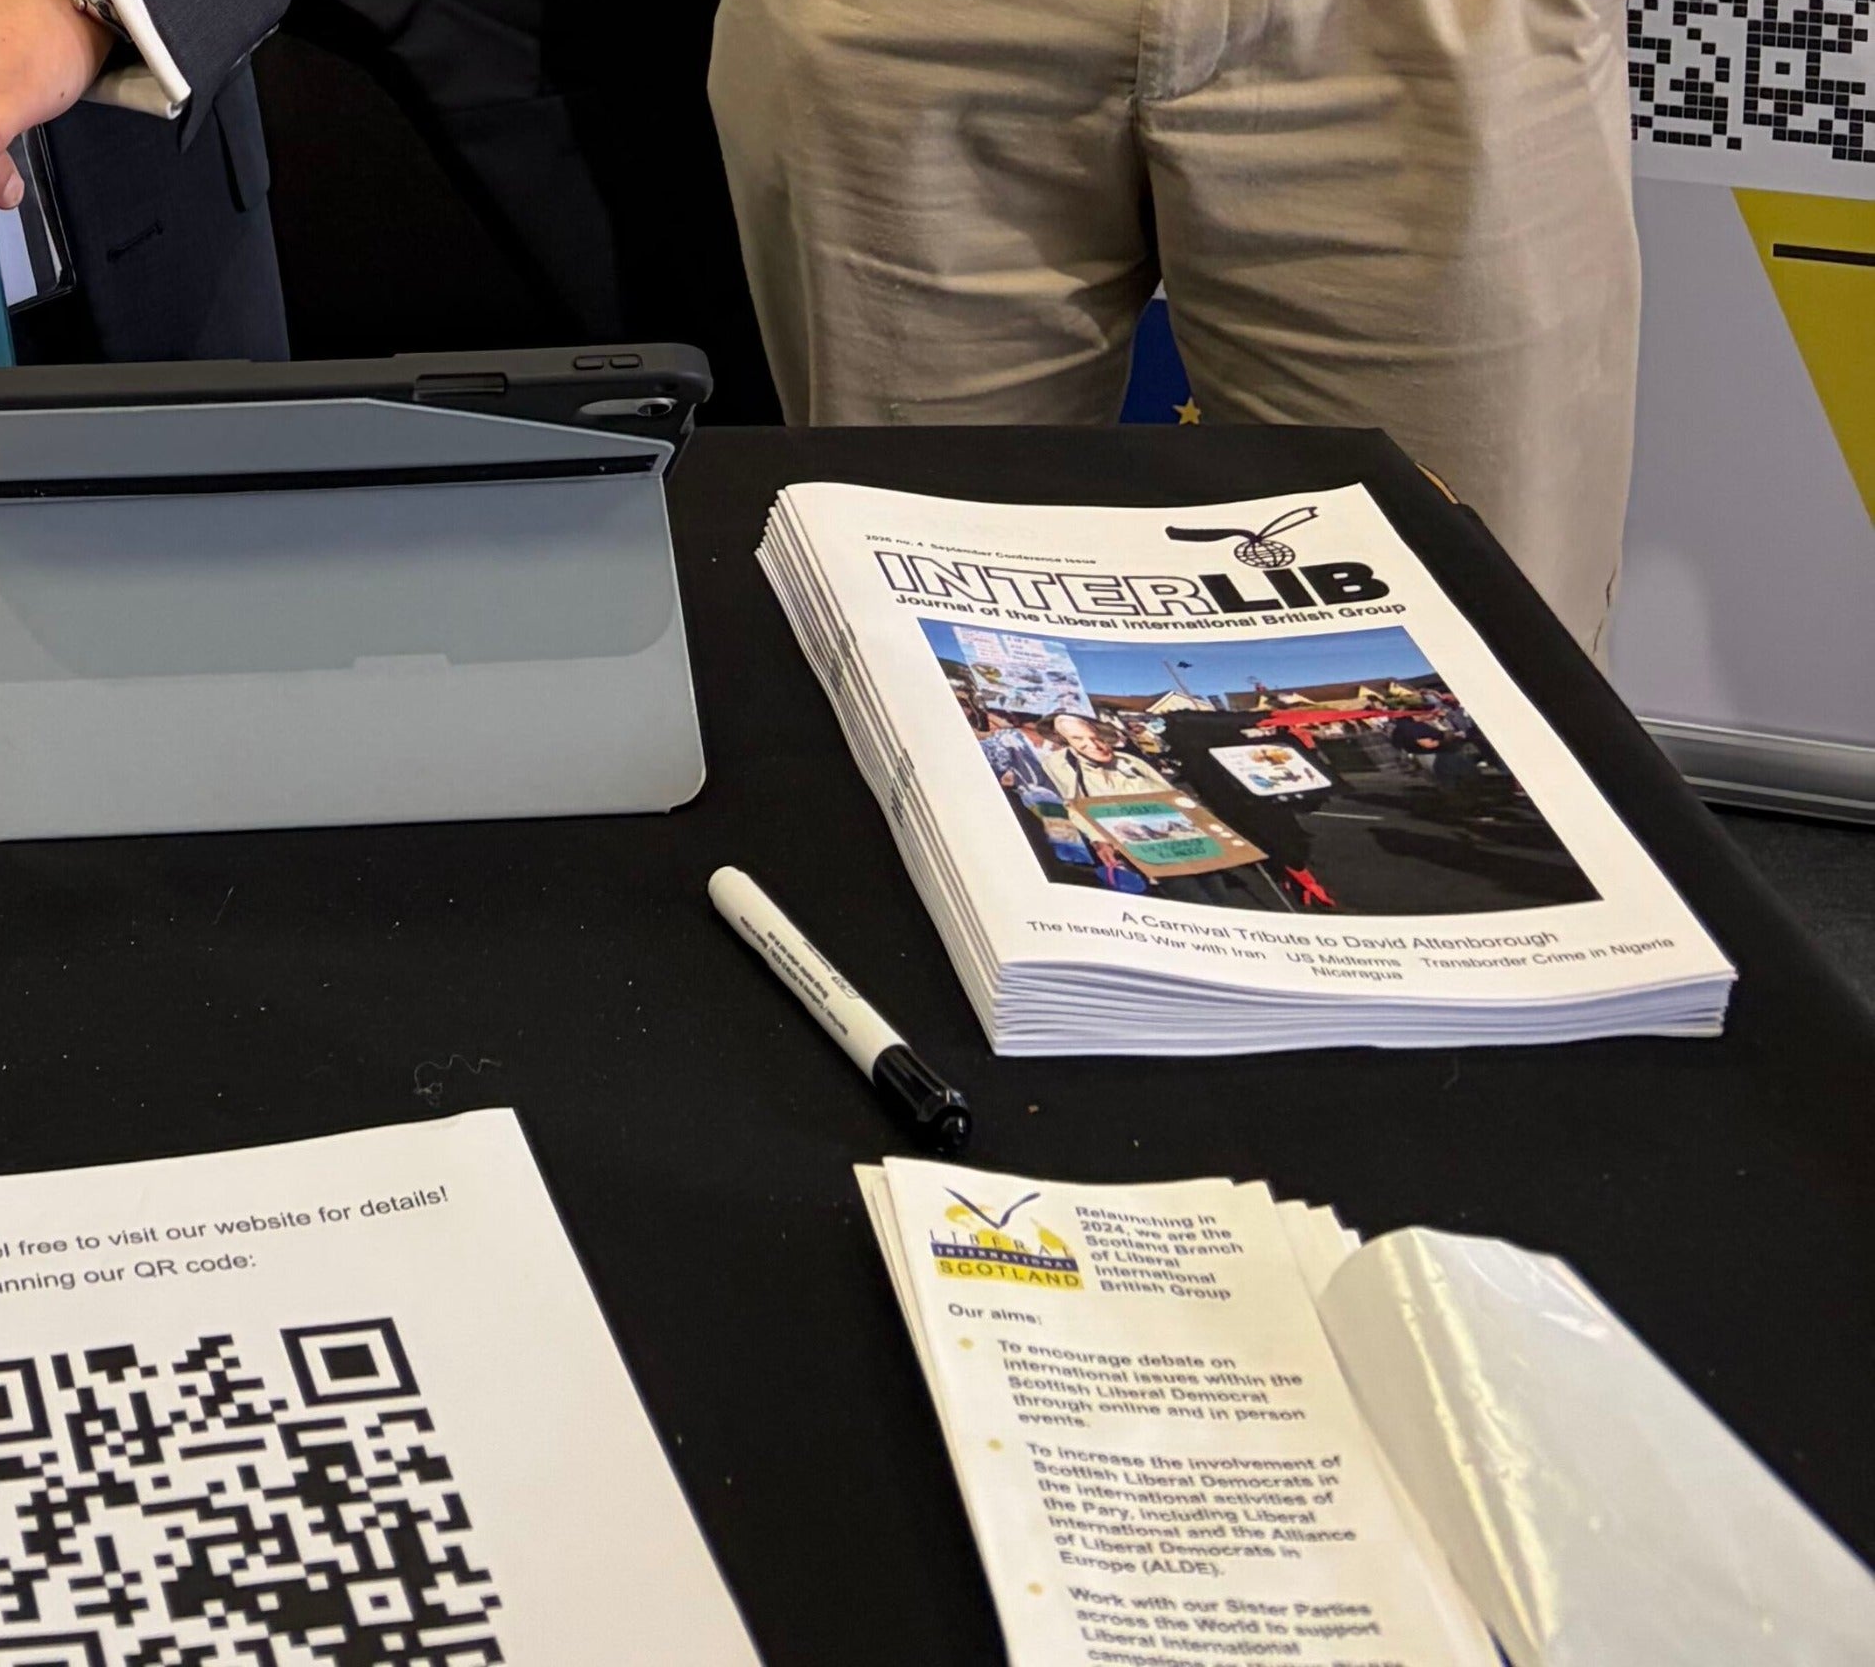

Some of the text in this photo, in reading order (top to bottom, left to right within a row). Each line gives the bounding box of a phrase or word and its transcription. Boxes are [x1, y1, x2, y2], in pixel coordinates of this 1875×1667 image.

[874, 550, 1391, 615] INTERLIB
[896, 594, 1406, 630] Journal of the Liberal International British Group
[1027, 921, 1062, 932] The
[1067, 923, 1147, 943] Israel/US
[1151, 935, 1185, 948] War
[1191, 944, 1227, 957] with
[1231, 947, 1266, 960] Iran
[1286, 952, 1315, 964] US
[1318, 953, 1402, 967] Midterms
[1420, 956, 1527, 969] Transborder
[1532, 951, 1586, 965] Crime
[1611, 939, 1675, 958] Nigeria
[1122, 911, 1558, 949] A Carnival Tribute to David Attenborough
[1311, 966, 1403, 981] Nicaragua
[19, 1240, 67, 1255] free
[76, 1236, 100, 1250] to
[108, 1228, 158, 1246] visit
[166, 1225, 206, 1240] our
[214, 1212, 311, 1235] website
[318, 1207, 350, 1223] for
[360, 1186, 448, 1217] details!
[84, 1268, 124, 1283] our
[134, 1260, 178, 1278] QR
[186, 1254, 256, 1273] code:
[940, 1261, 1079, 1286] SCOTLAND
